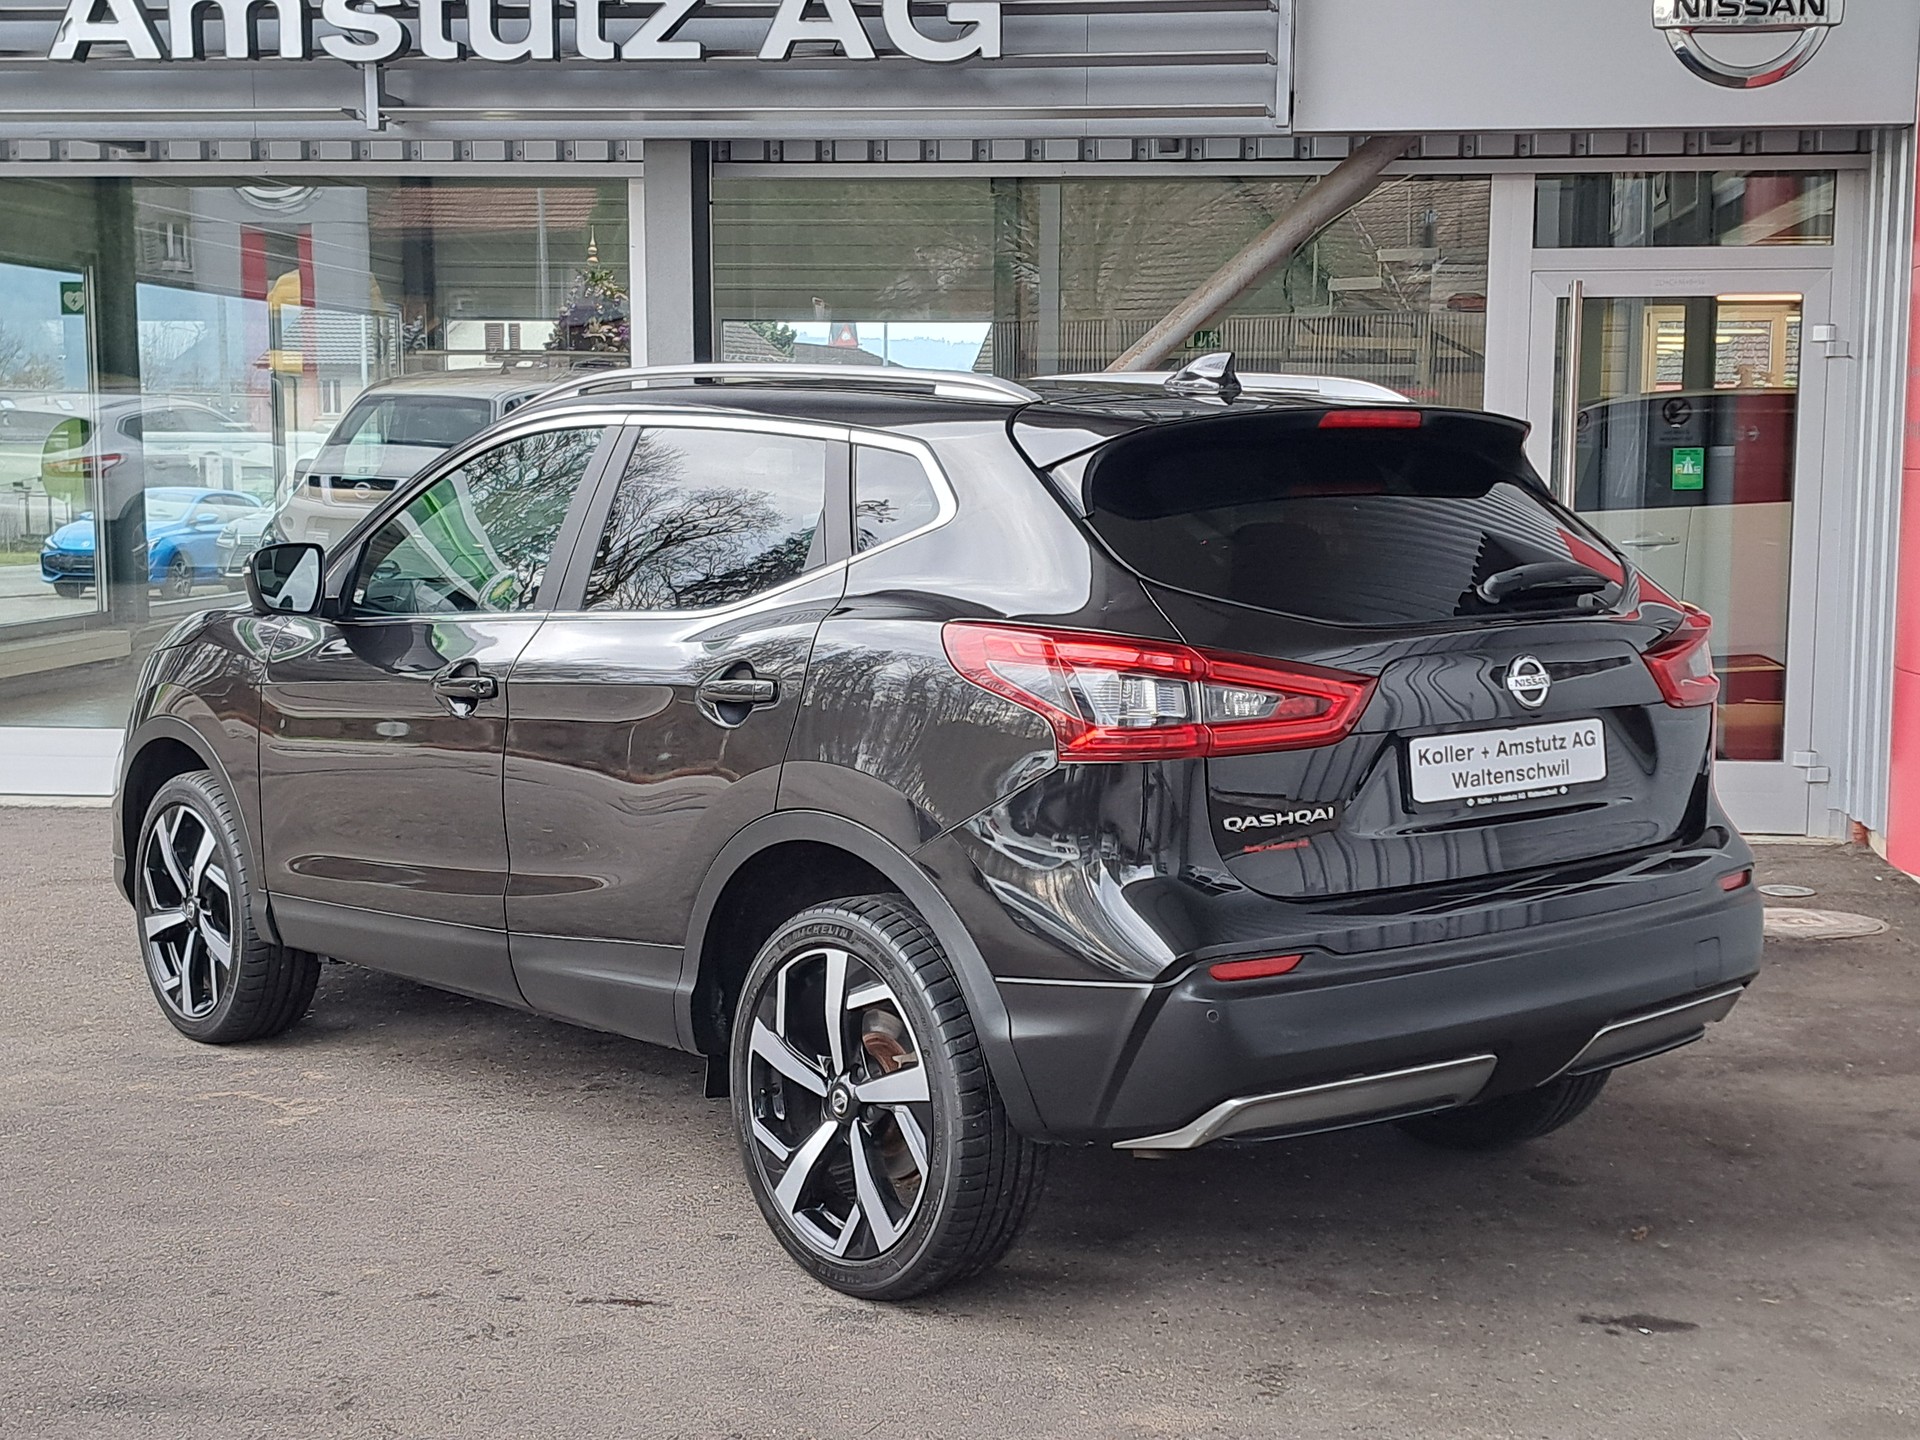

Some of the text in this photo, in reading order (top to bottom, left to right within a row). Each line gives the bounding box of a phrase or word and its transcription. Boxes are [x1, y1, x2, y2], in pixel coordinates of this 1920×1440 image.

[1672, 0, 1825, 18] NISSAN
[757, 0, 1001, 62] AG
[1418, 730, 1597, 767] Koller + Amstutz AG
[1452, 758, 1570, 789] Waltenschwil
[1223, 806, 1334, 833] QASHQAI
